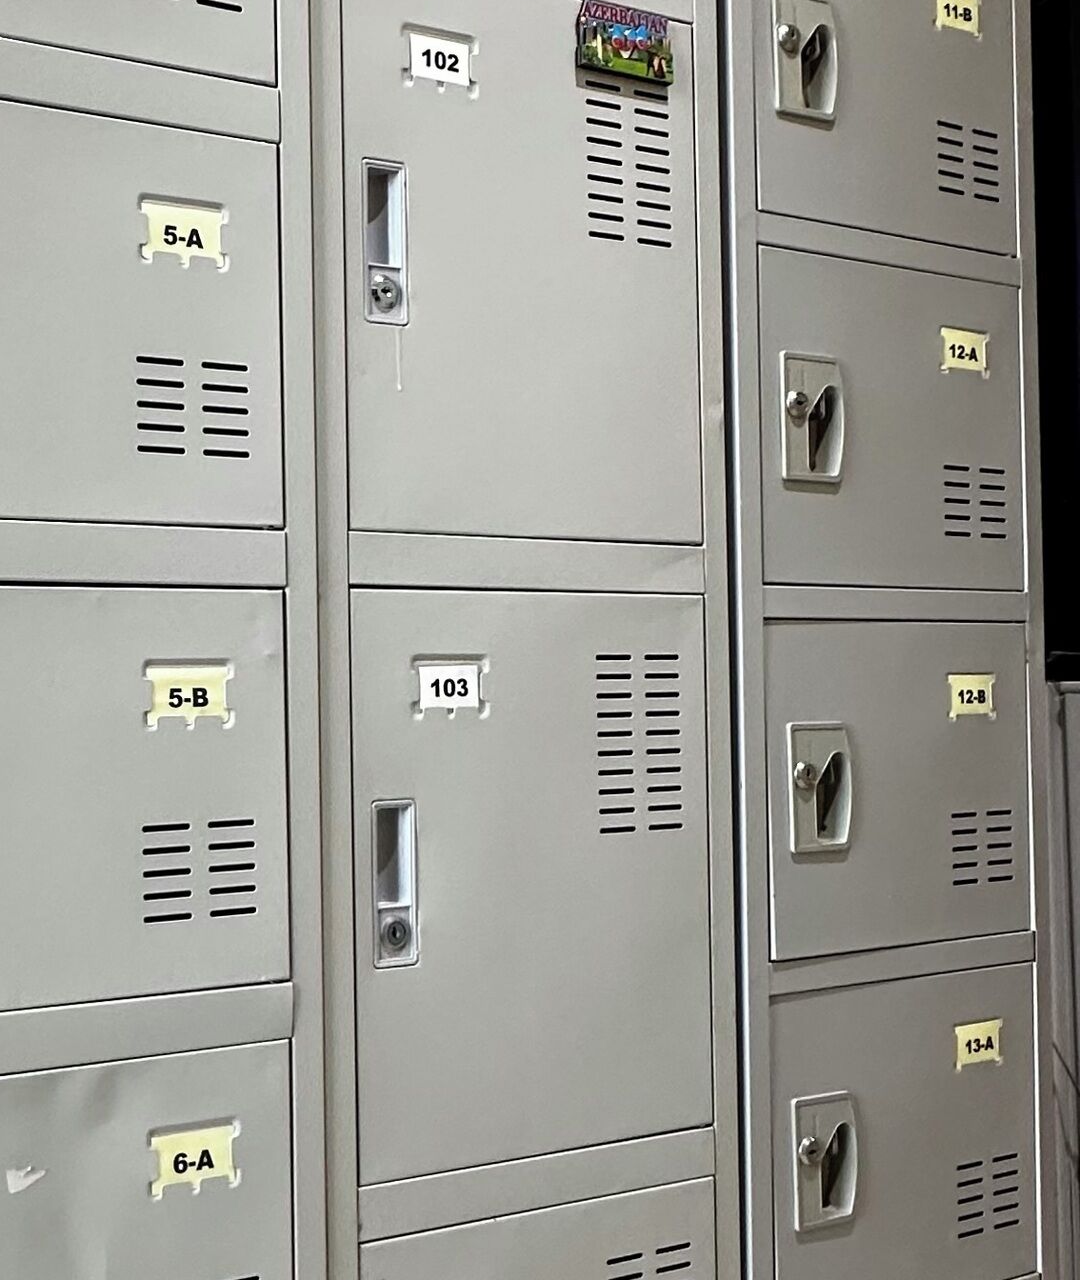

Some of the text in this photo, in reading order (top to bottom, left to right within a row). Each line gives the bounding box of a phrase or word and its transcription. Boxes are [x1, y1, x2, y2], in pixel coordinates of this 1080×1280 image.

[943, 3, 973, 23] 11-B
[421, 47, 460, 74] 102
[163, 224, 204, 250] 5-A
[948, 343, 979, 363] 12-A
[168, 687, 209, 709] 5-B
[430, 678, 471, 698] 103
[957, 689, 987, 705] 12-B
[965, 1035, 995, 1055] 13-A
[173, 1148, 215, 1175] 6-A
